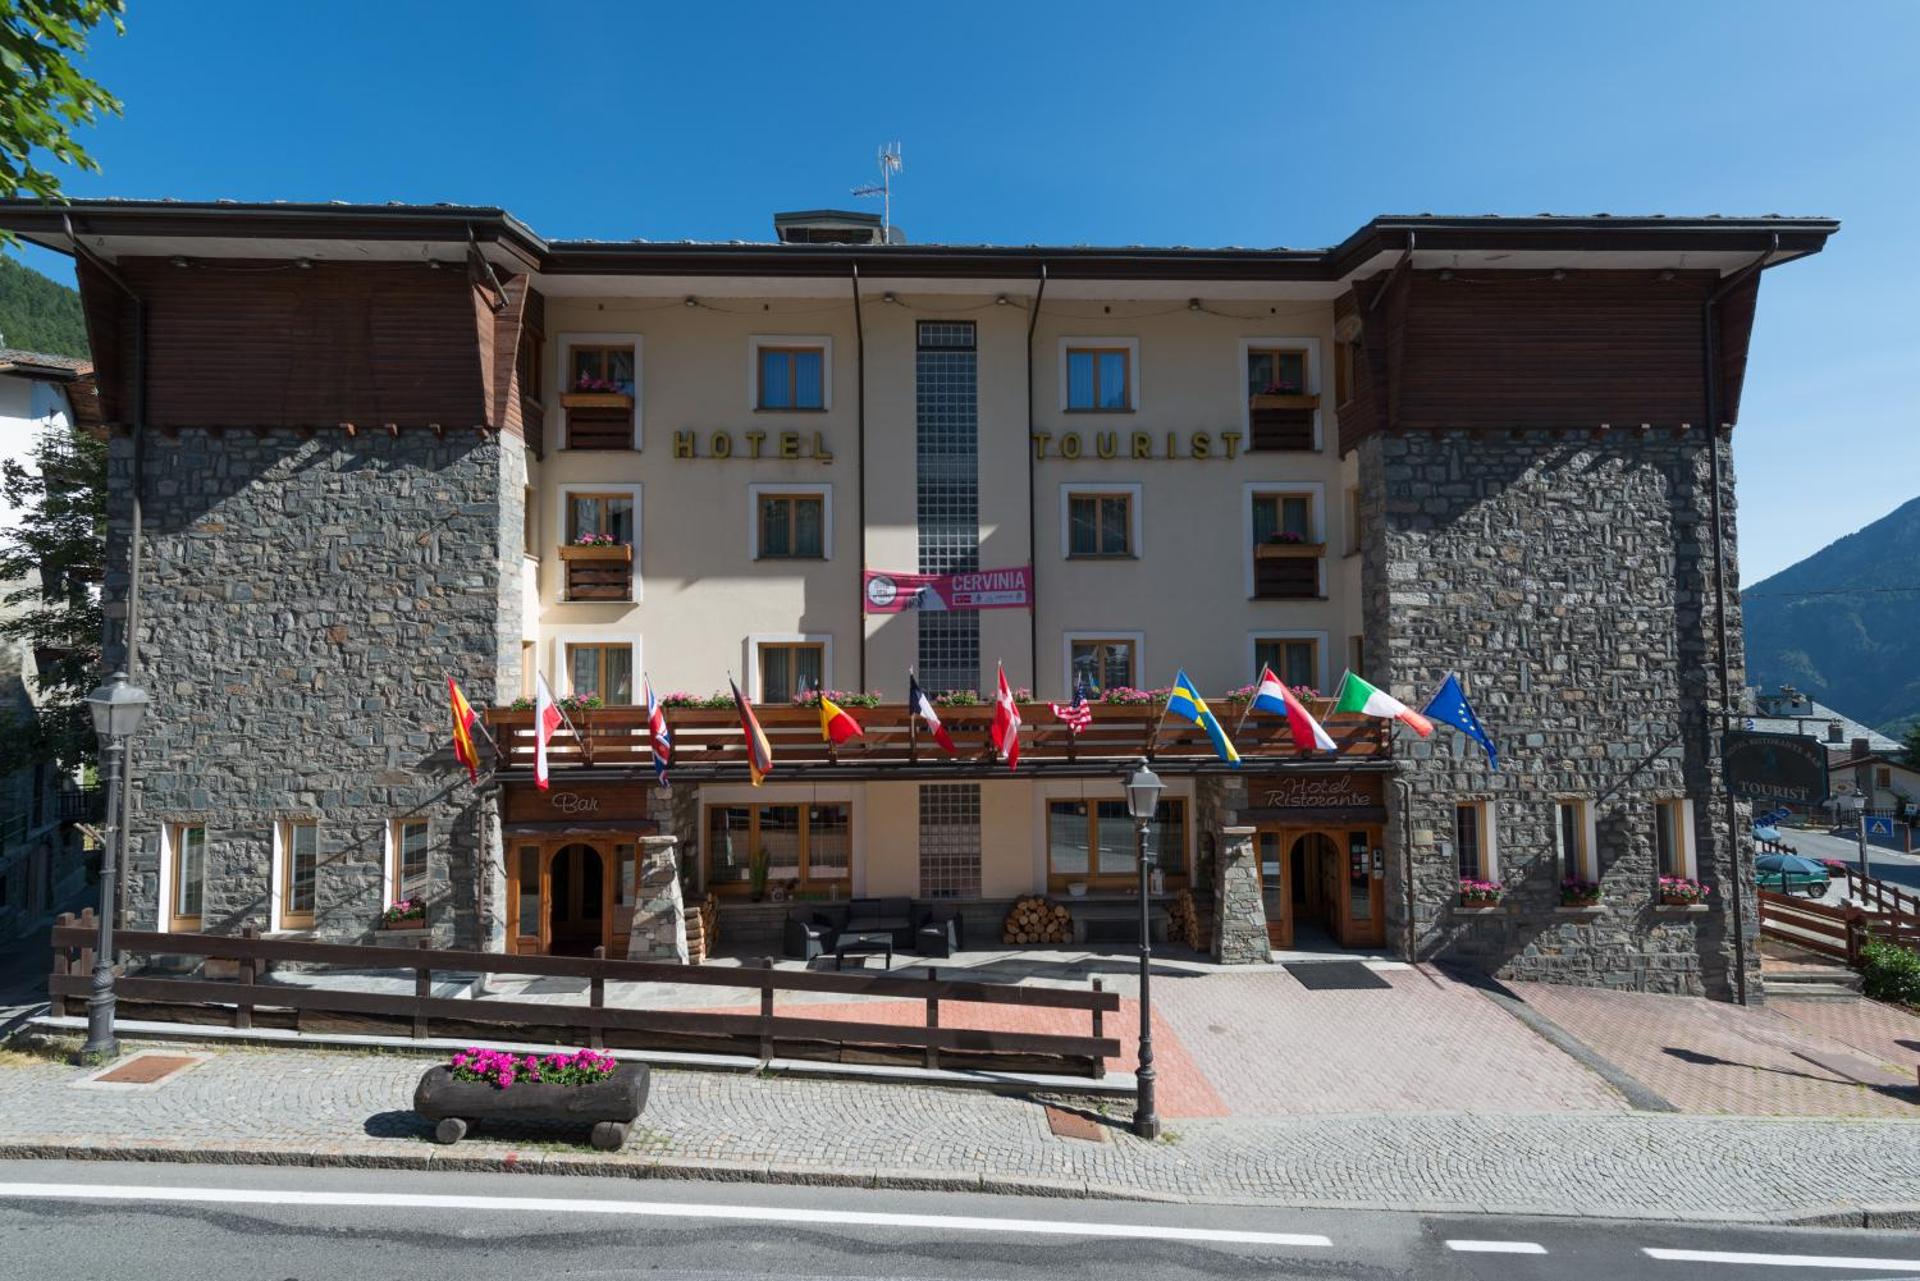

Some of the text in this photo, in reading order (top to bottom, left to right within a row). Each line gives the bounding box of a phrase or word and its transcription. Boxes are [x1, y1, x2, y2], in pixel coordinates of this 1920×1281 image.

[673, 431, 1243, 460] HOTEL TOURIST
[952, 571, 1025, 591] CERVINIA
[1282, 775, 1351, 793] Hotel
[1738, 779, 1809, 800] TOURIST
[552, 792, 599, 813] Bar
[1265, 790, 1371, 807] Ristorante
